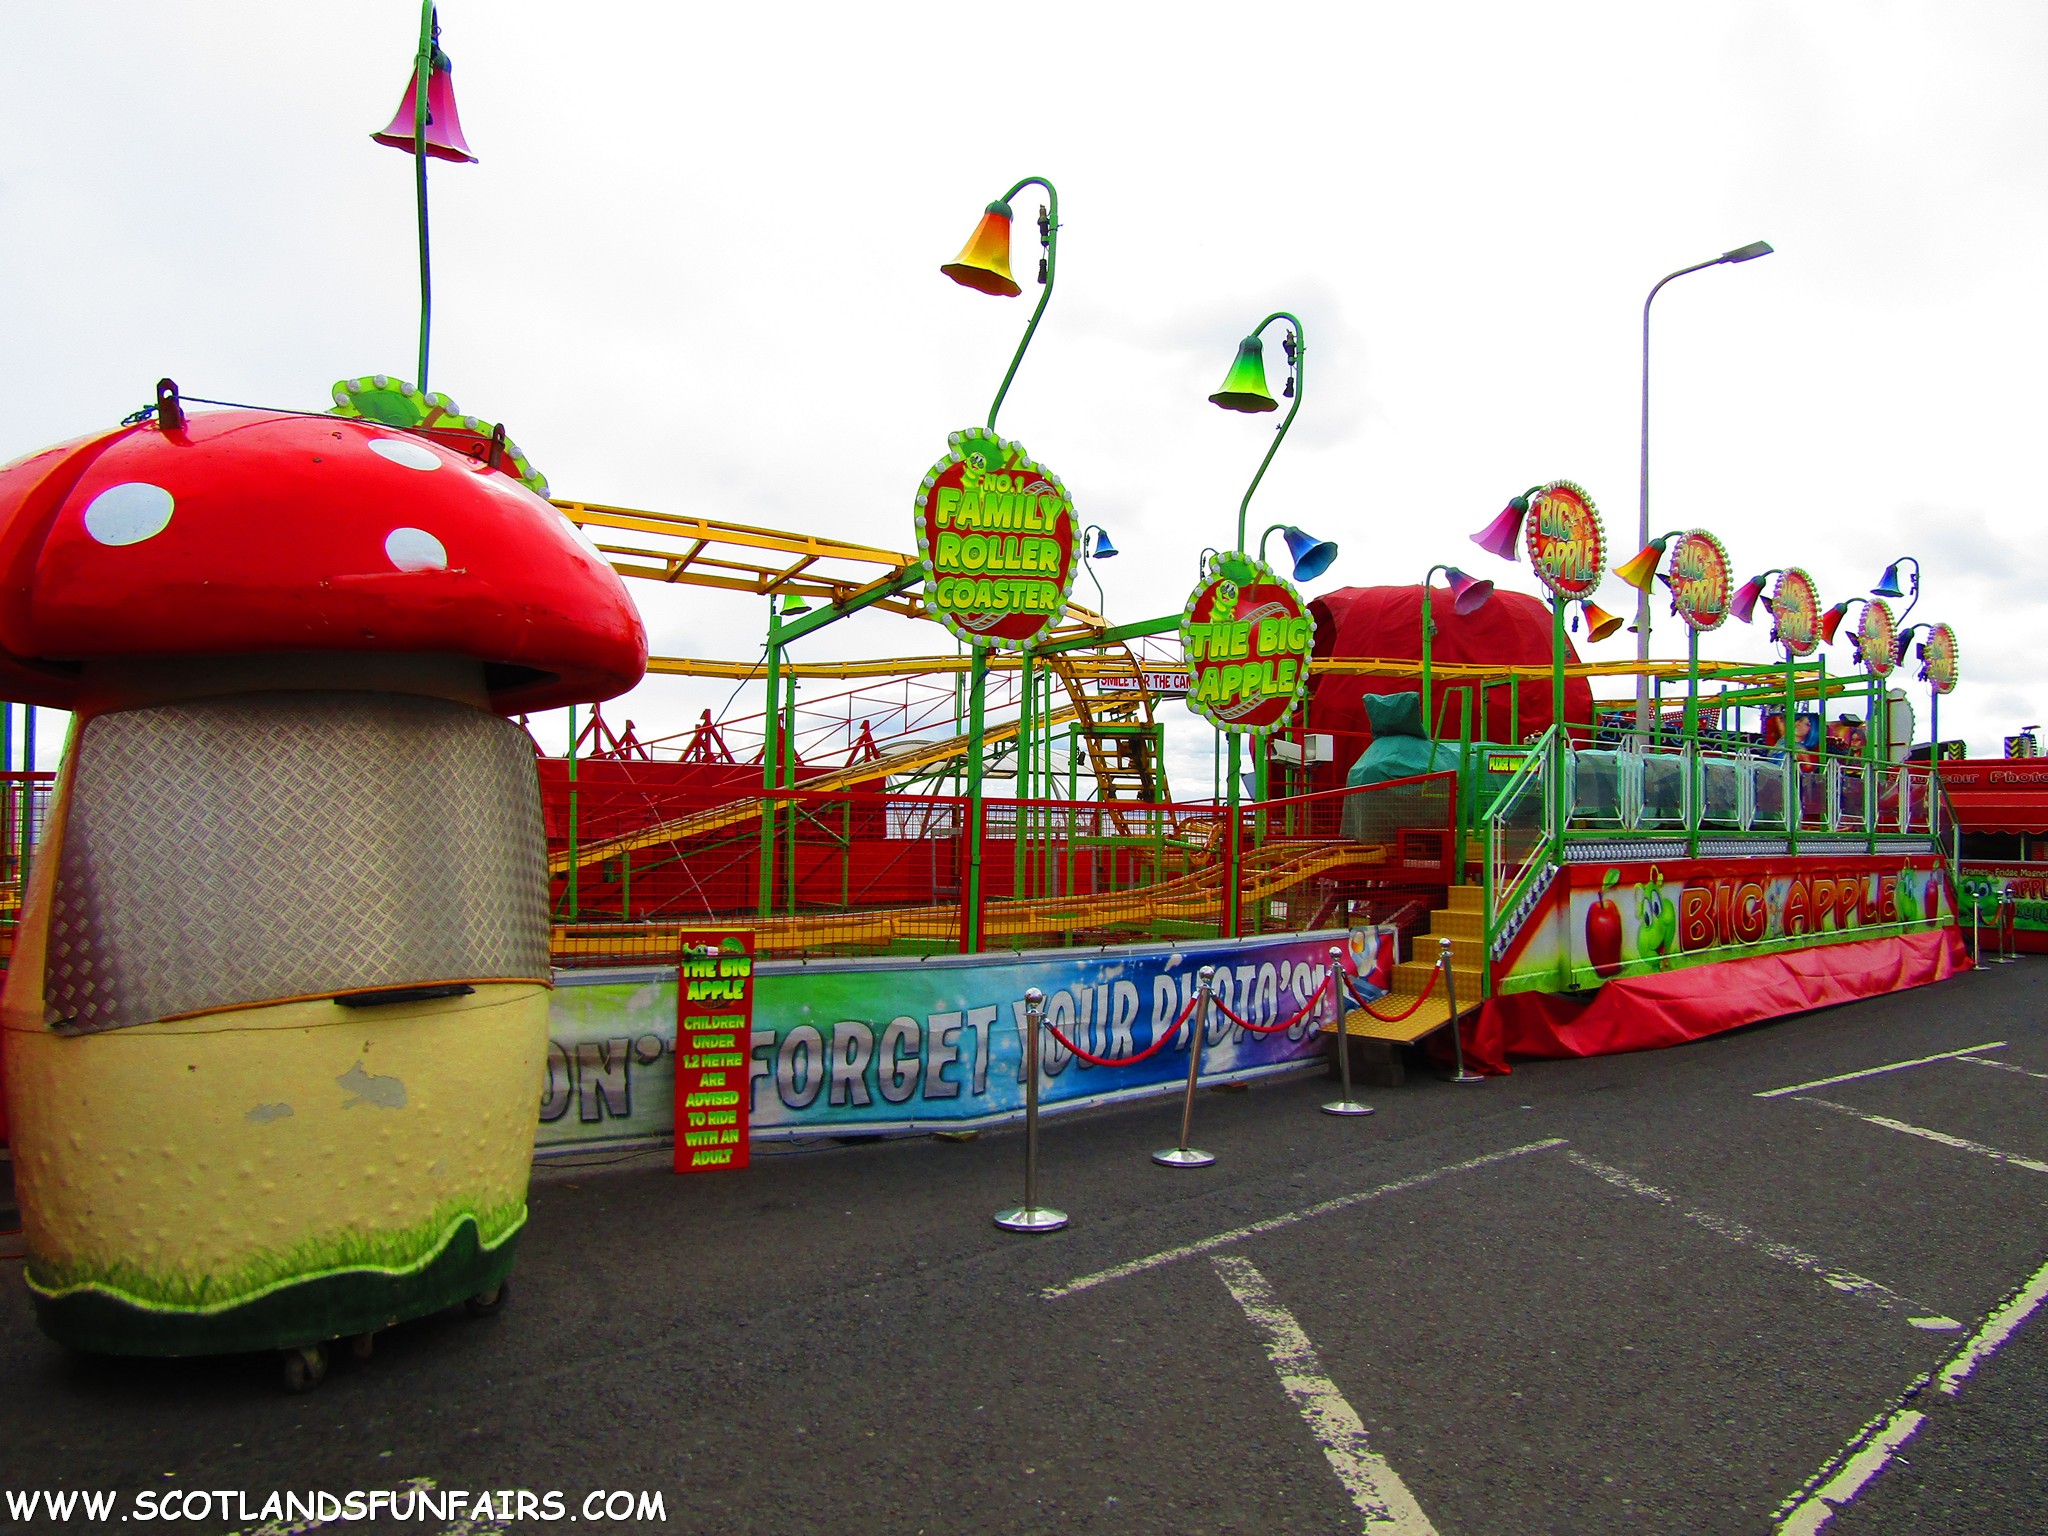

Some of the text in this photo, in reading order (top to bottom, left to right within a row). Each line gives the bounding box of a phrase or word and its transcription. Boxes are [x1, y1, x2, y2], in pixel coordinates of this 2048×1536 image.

[983, 474, 1025, 494] NO.1
[936, 487, 1064, 533] FAMILY
[1539, 495, 1571, 541] BIG
[937, 533, 1062, 576] ROLLER
[1542, 539, 1594, 582] APPLE
[1679, 543, 1704, 580] BIG
[936, 579, 1060, 614] COASTER
[1681, 577, 1724, 614] APPLE
[1189, 617, 1307, 662] THE BIG
[1132, 674, 1150, 688] FR
[1154, 674, 1170, 689] THE
[1197, 660, 1298, 705] APPLE
[1680, 874, 1899, 953] BIG APPLE
[682, 956, 751, 979] THE BIG
[687, 979, 745, 1001] APPLE
[683, 1015, 746, 1031] CHILDREN
[692, 1033, 735, 1049] UNDER
[750, 1004, 997, 1112] FORGET
[1012, 979, 1139, 1083] YOUR
[683, 1052, 743, 1069] 1.2 METRE
[699, 1072, 726, 1088] ARE
[685, 1091, 740, 1108] ADVISED
[688, 1110, 737, 1127] TO RIDE
[685, 1129, 739, 1147] WITH AN
[691, 1149, 733, 1167] ADULT
